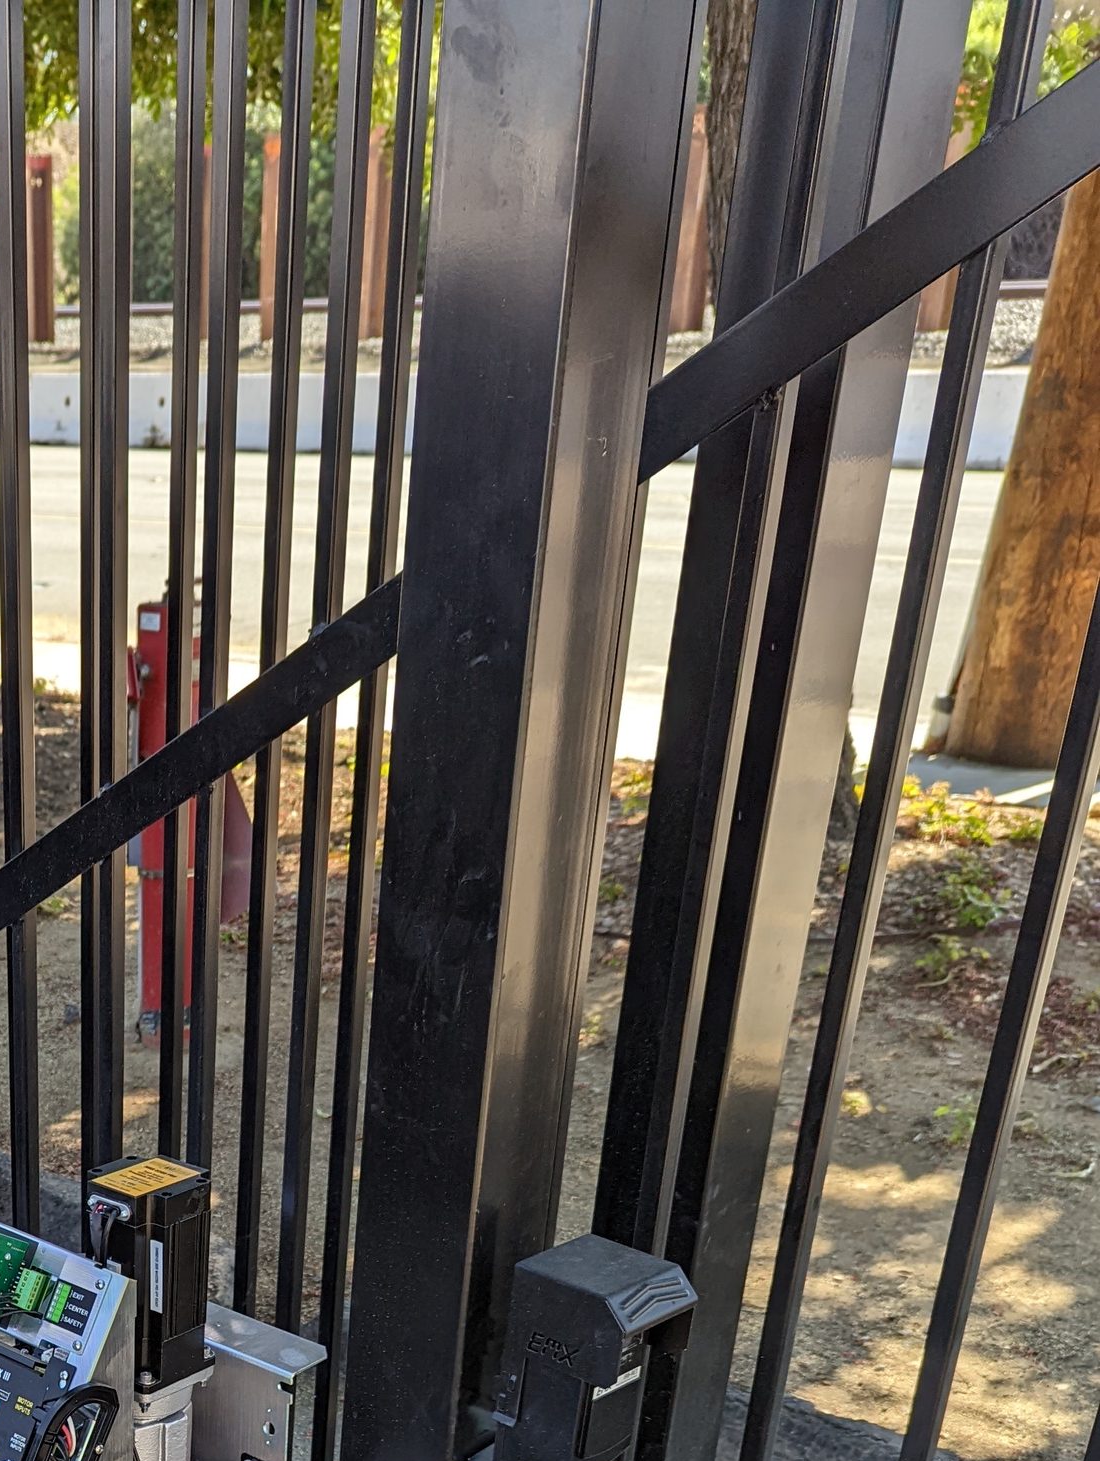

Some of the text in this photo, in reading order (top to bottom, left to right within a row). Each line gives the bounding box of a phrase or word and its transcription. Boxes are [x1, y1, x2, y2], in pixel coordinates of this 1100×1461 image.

[72, 1292, 85, 1300] EXIT
[68, 1303, 88, 1316] CENTER
[64, 1316, 84, 1329] SAFETY
[2, 1372, 11, 1381] III
[17, 1397, 34, 1408] MOTOR
[14, 1404, 31, 1415] INPUTS
